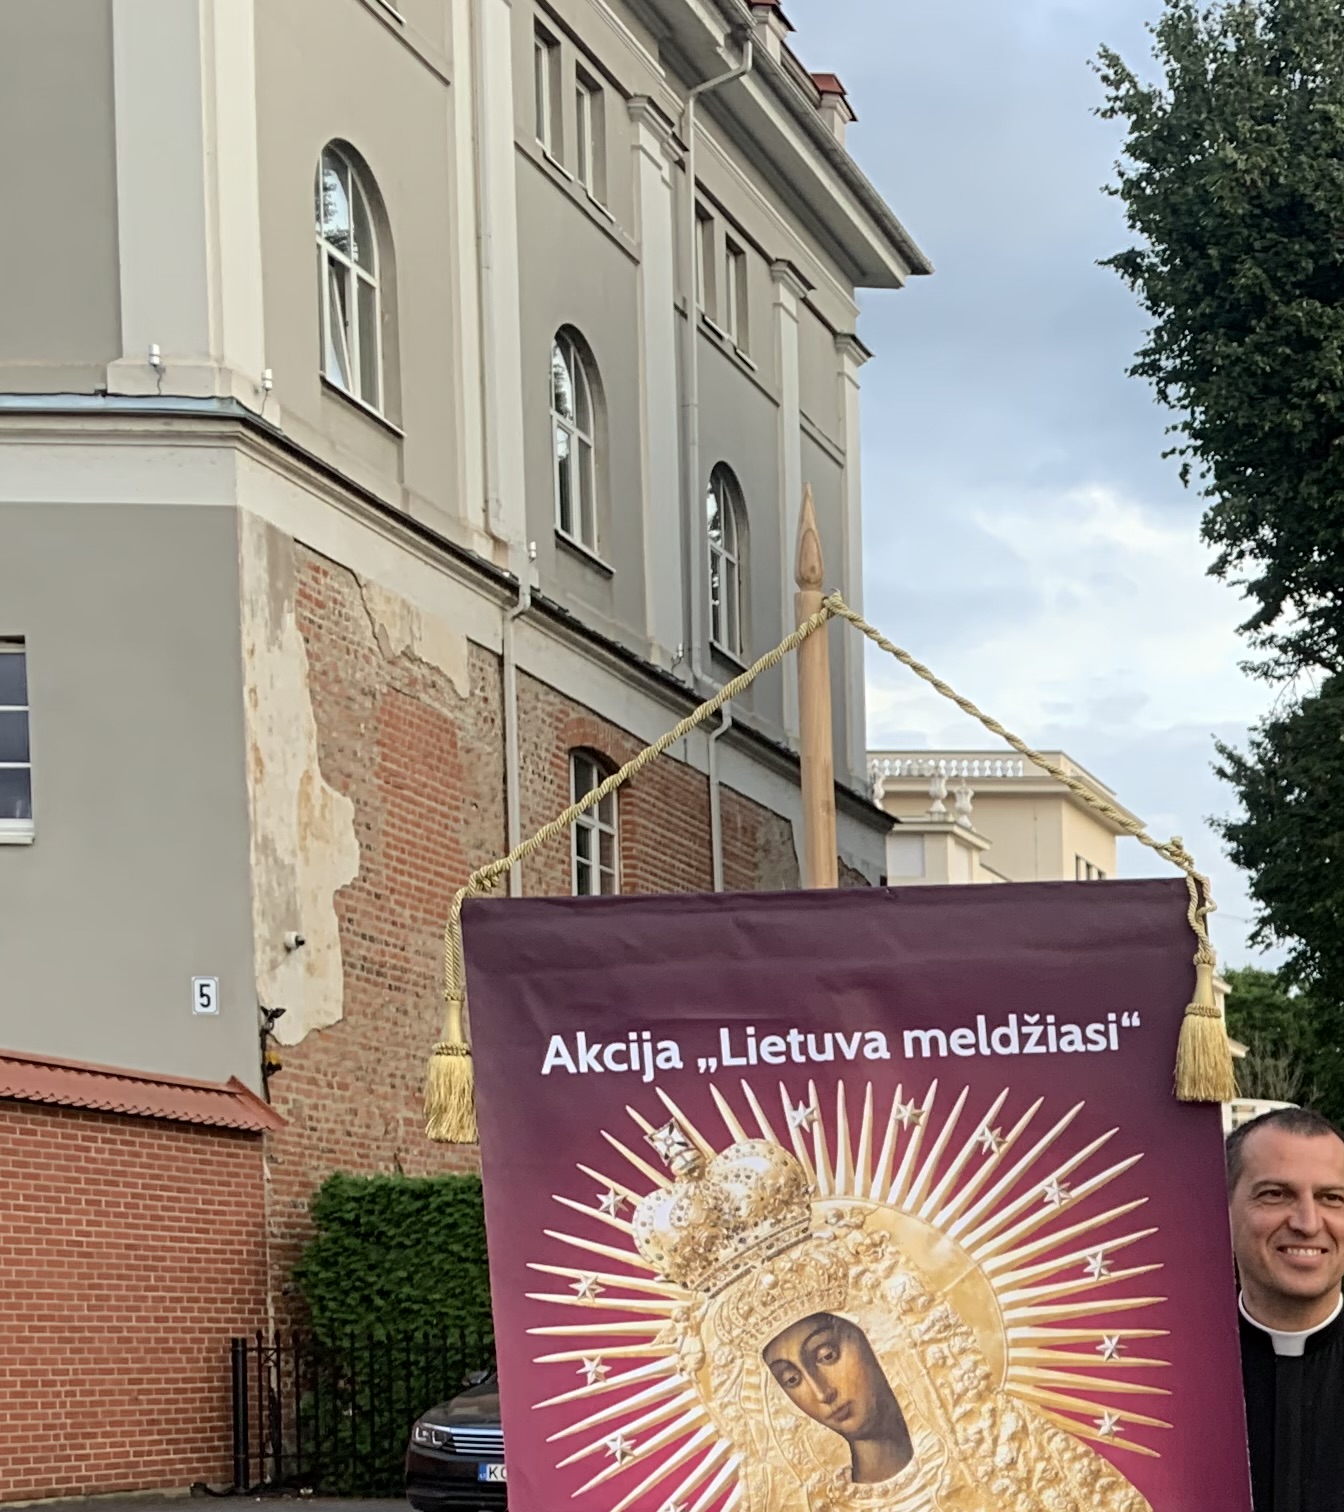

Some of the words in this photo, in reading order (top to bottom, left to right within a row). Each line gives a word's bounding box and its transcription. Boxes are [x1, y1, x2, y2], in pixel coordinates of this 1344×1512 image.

[199, 983, 211, 1009] 5
[541, 1026, 685, 1083] Akcija
[697, 1025, 891, 1075] „Lietuva
[903, 1010, 1142, 1060] meldžiasi“
